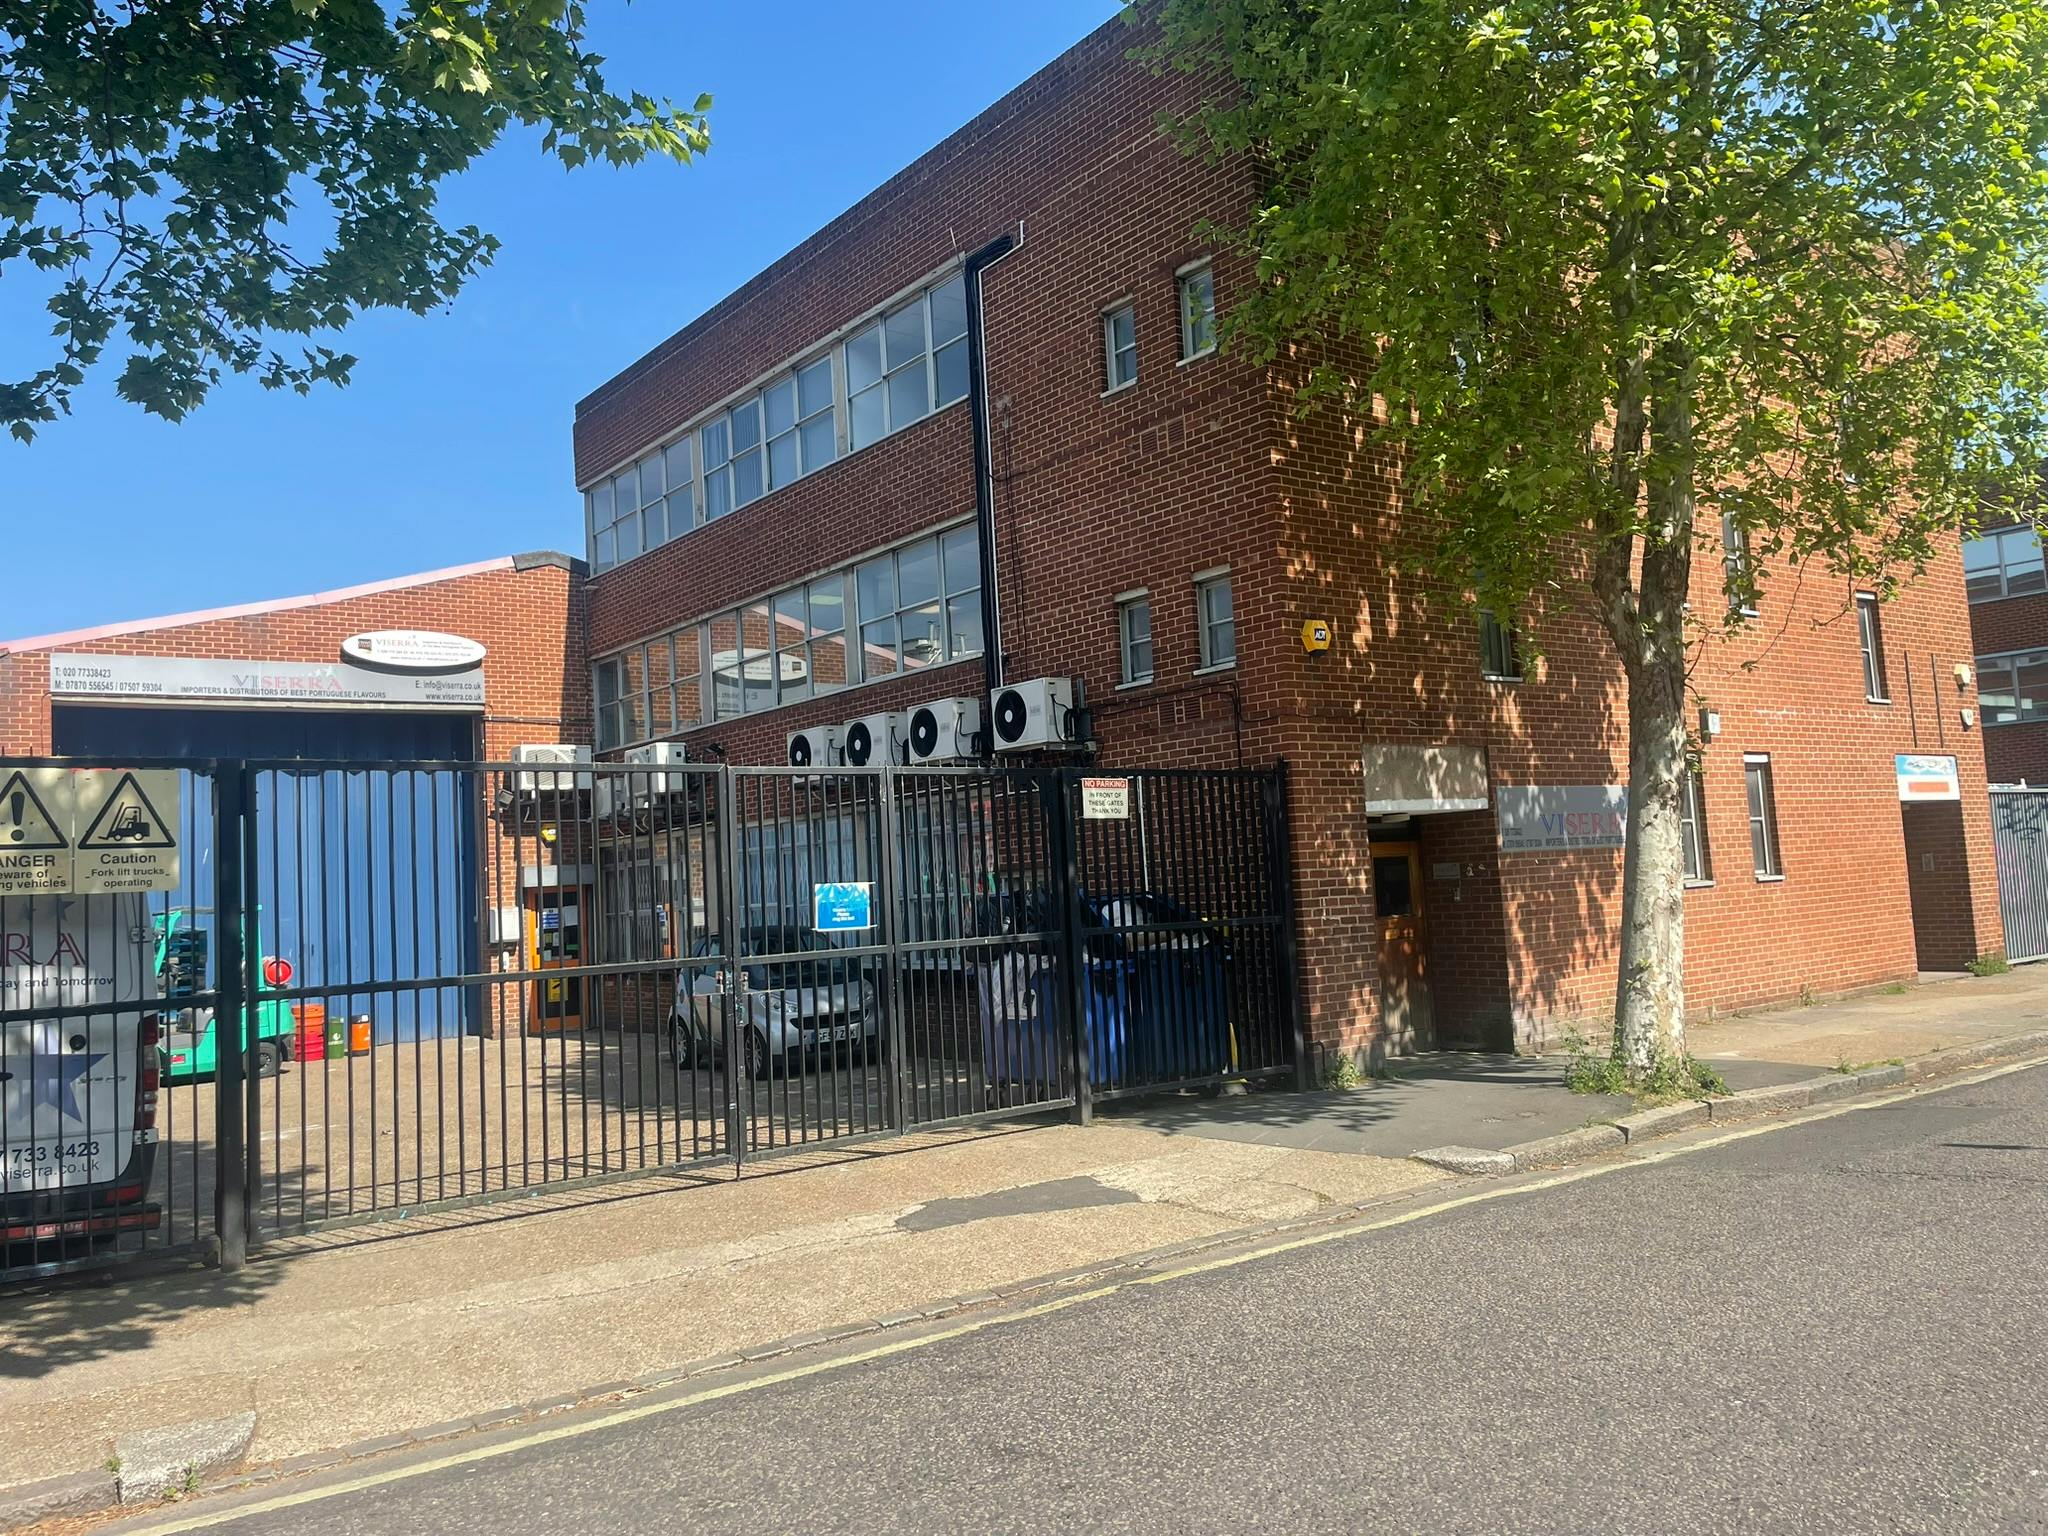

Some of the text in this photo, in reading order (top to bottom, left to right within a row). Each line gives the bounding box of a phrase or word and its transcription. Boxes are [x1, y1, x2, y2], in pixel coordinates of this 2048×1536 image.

[63, 667, 76, 676] 020
[78, 668, 111, 678] 77338423
[65, 681, 87, 690] 07870
[232, 674, 343, 690] VISERRA
[423, 680, 482, 691] info@viserra.co.uk
[181, 686, 386, 699] IMPORTERS & DISTRIBUTORS OF BEST PORTUGUESE FLAVOURS
[425, 693, 482, 701] www.viserra.co.uk
[1084, 780, 1126, 788] NO PARKING
[100, 853, 157, 865] Caution
[37, 869, 49, 878] of
[91, 867, 165, 877] Fork lift trucks
[17, 878, 67, 889] vehicles
[104, 879, 153, 889] operating
[0, 932, 87, 967] RA
[25, 977, 49, 988] and
[12, 1146, 47, 1164] 733
[54, 1141, 100, 1159] 8423
